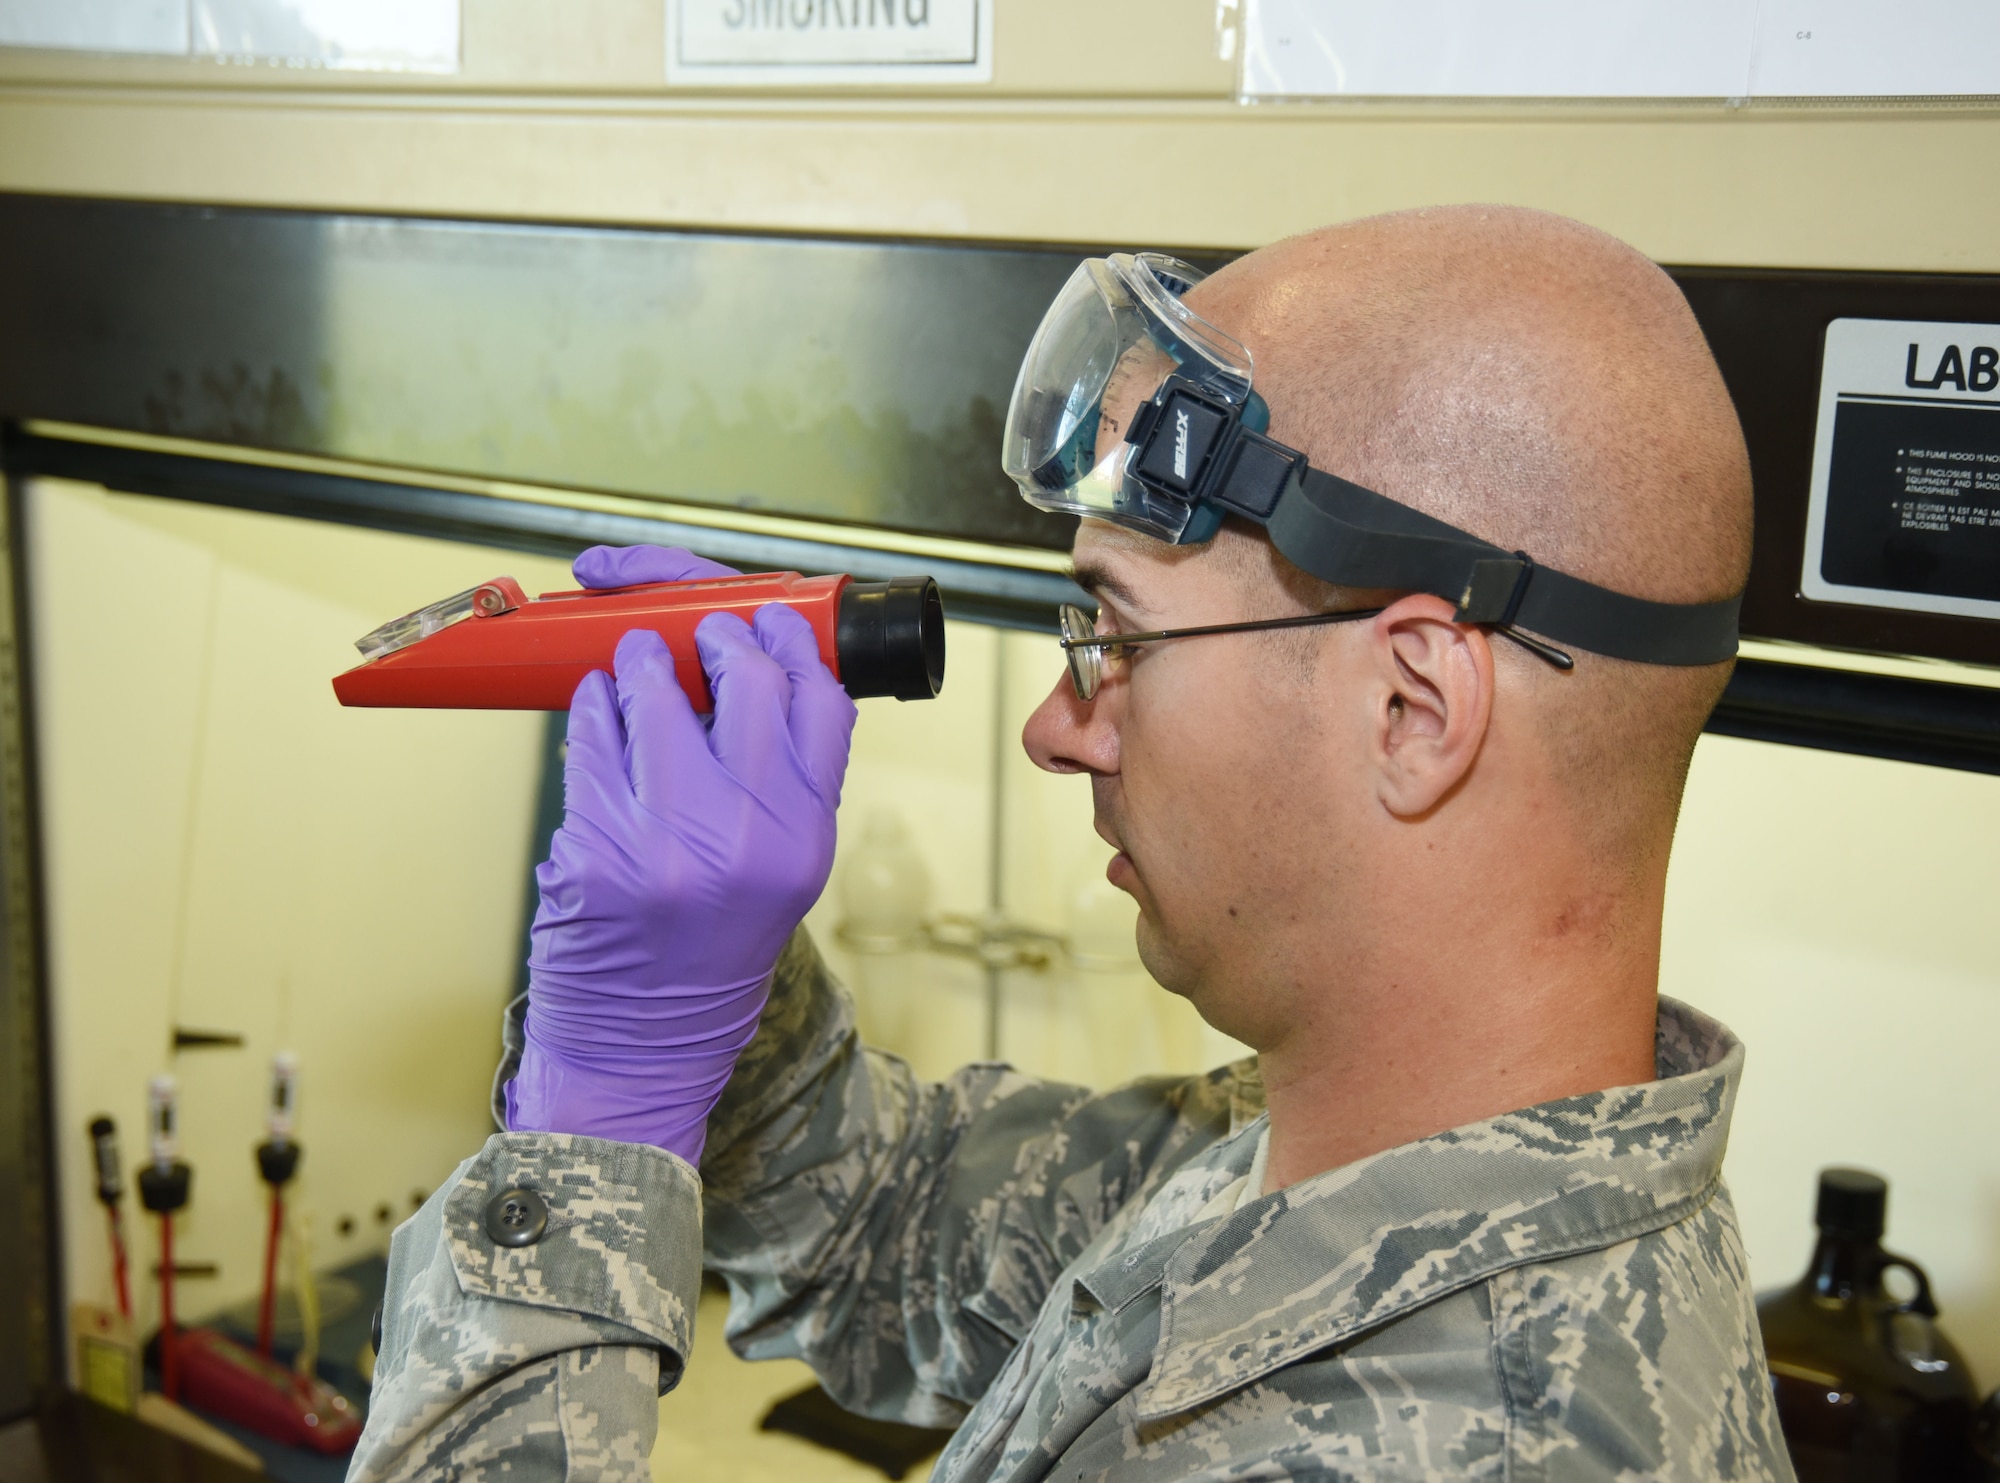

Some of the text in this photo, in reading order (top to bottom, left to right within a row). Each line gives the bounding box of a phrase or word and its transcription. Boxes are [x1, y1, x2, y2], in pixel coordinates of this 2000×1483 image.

[1905, 343, 2000, 392] LAB
[1909, 449, 1925, 458] THIS
[1926, 450, 1948, 459] FUME
[1949, 452, 1975, 461] HOOD
[1976, 454, 1984, 462] IS
[1925, 468, 1972, 479] ENCLOSURE
[1975, 472, 1983, 480] IS
[1906, 476, 1950, 486] EQUIPMENT
[1953, 480, 1971, 488] AND
[1973, 508, 1988, 516] PAS
[1950, 515, 1966, 524] PAS
